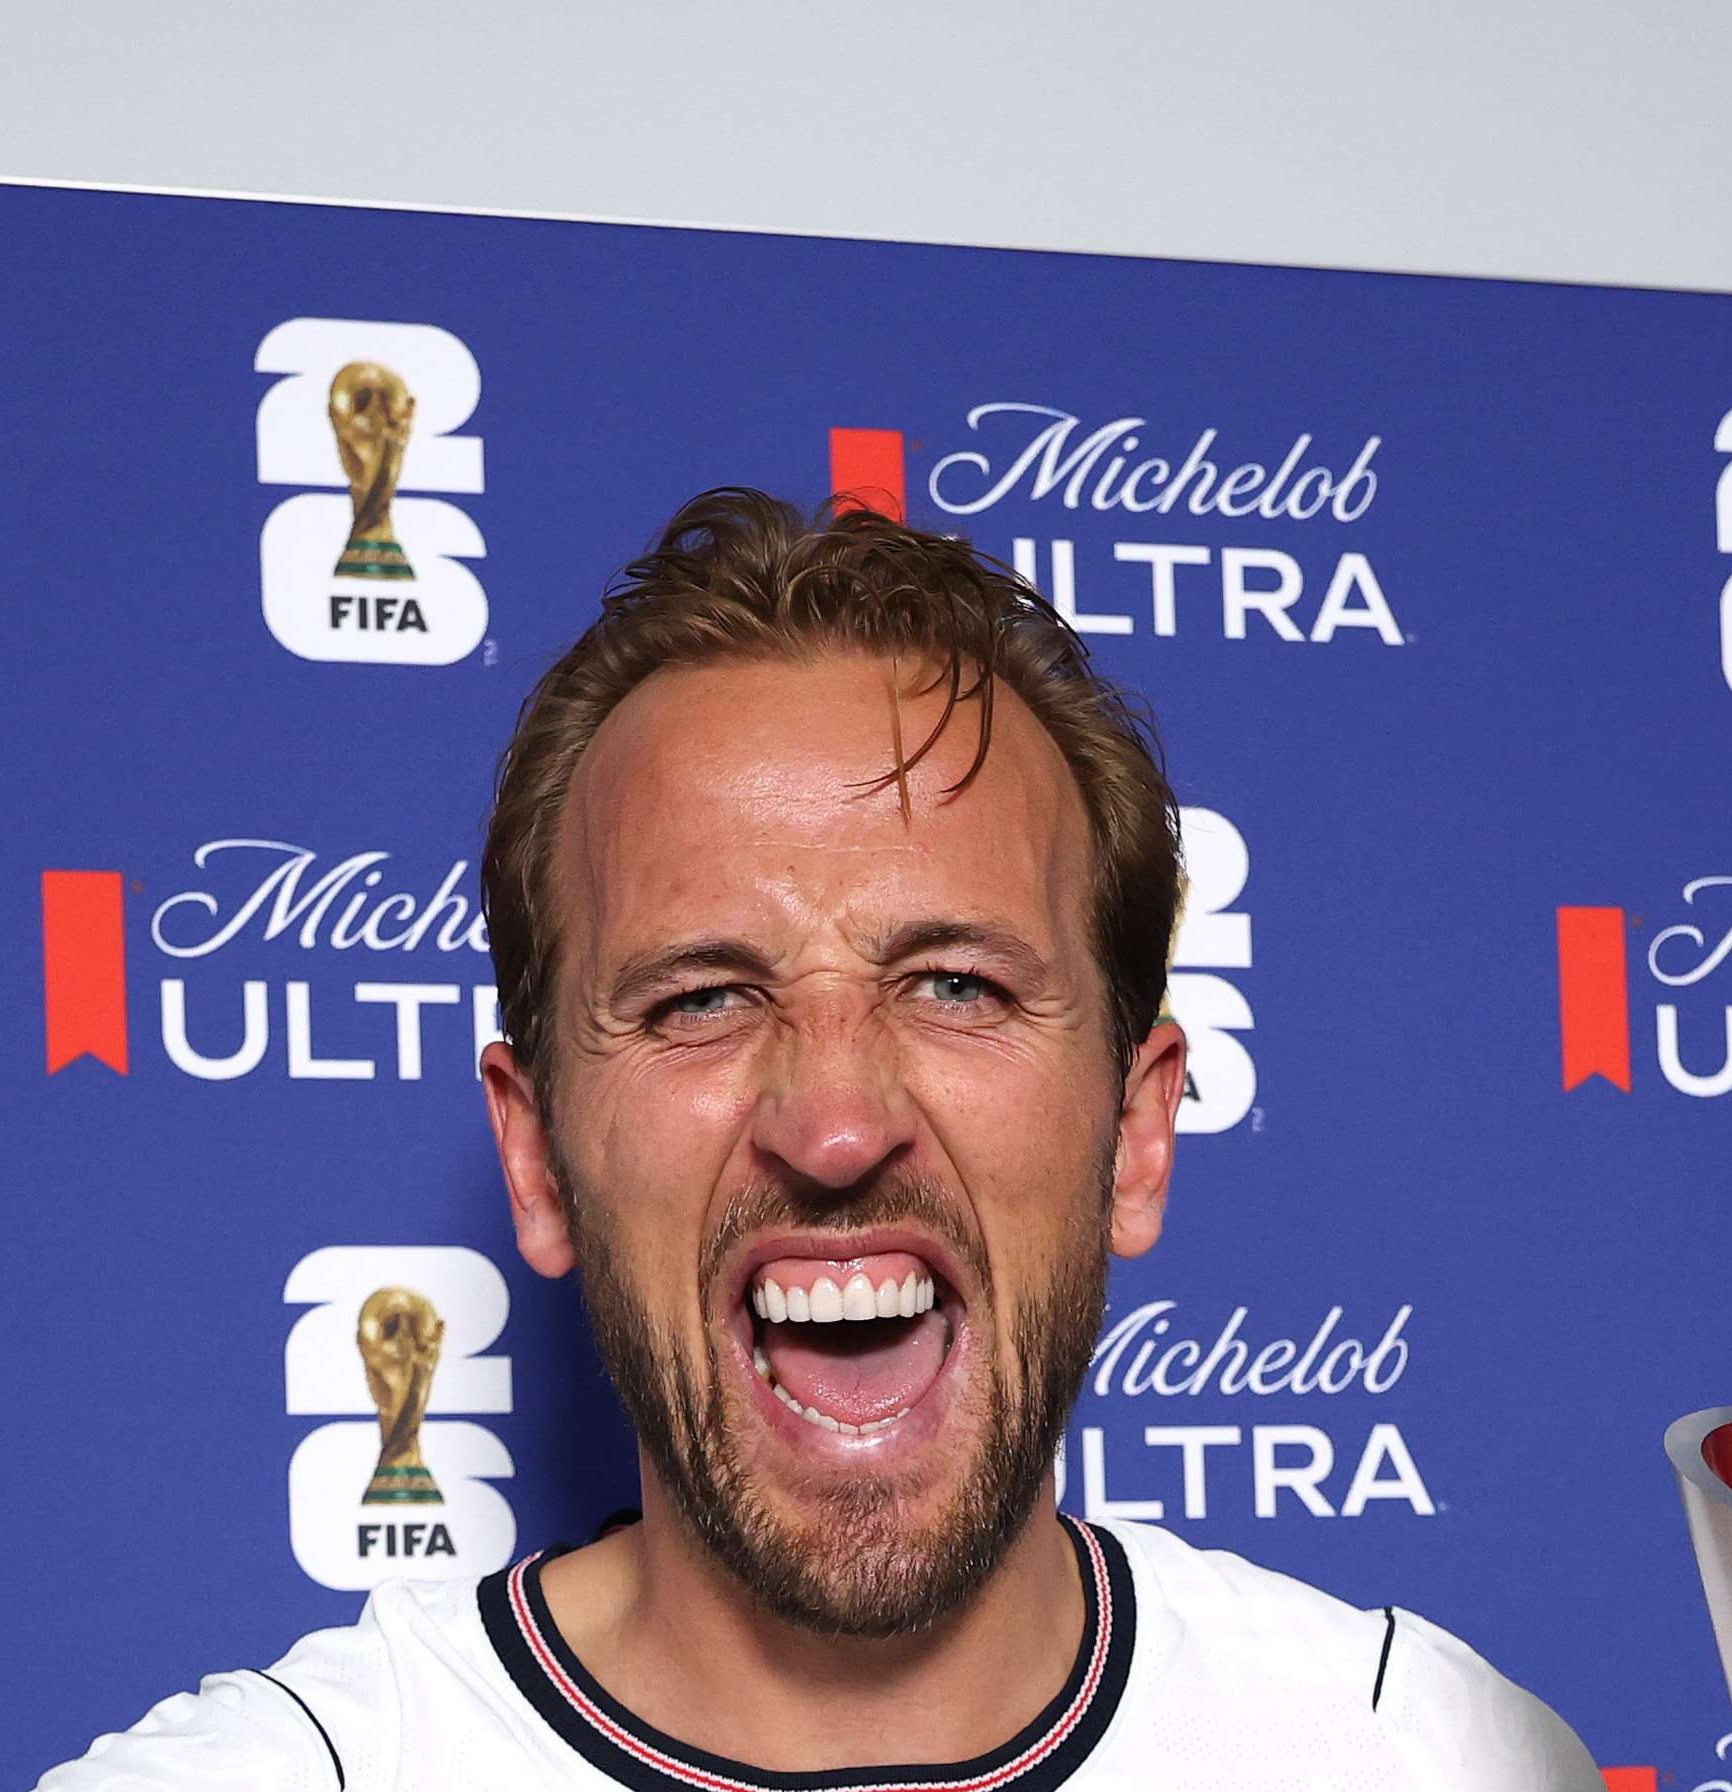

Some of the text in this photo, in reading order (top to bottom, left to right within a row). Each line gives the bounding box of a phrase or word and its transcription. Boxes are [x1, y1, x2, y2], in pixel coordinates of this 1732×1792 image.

[930, 404, 1380, 521] Michelob
[331, 596, 427, 632] FIFA
[152, 839, 491, 957] Mich
[161, 979, 507, 1081] ULT
[1055, 1424, 1435, 1520] LTRA
[359, 1524, 456, 1556] FIFA
